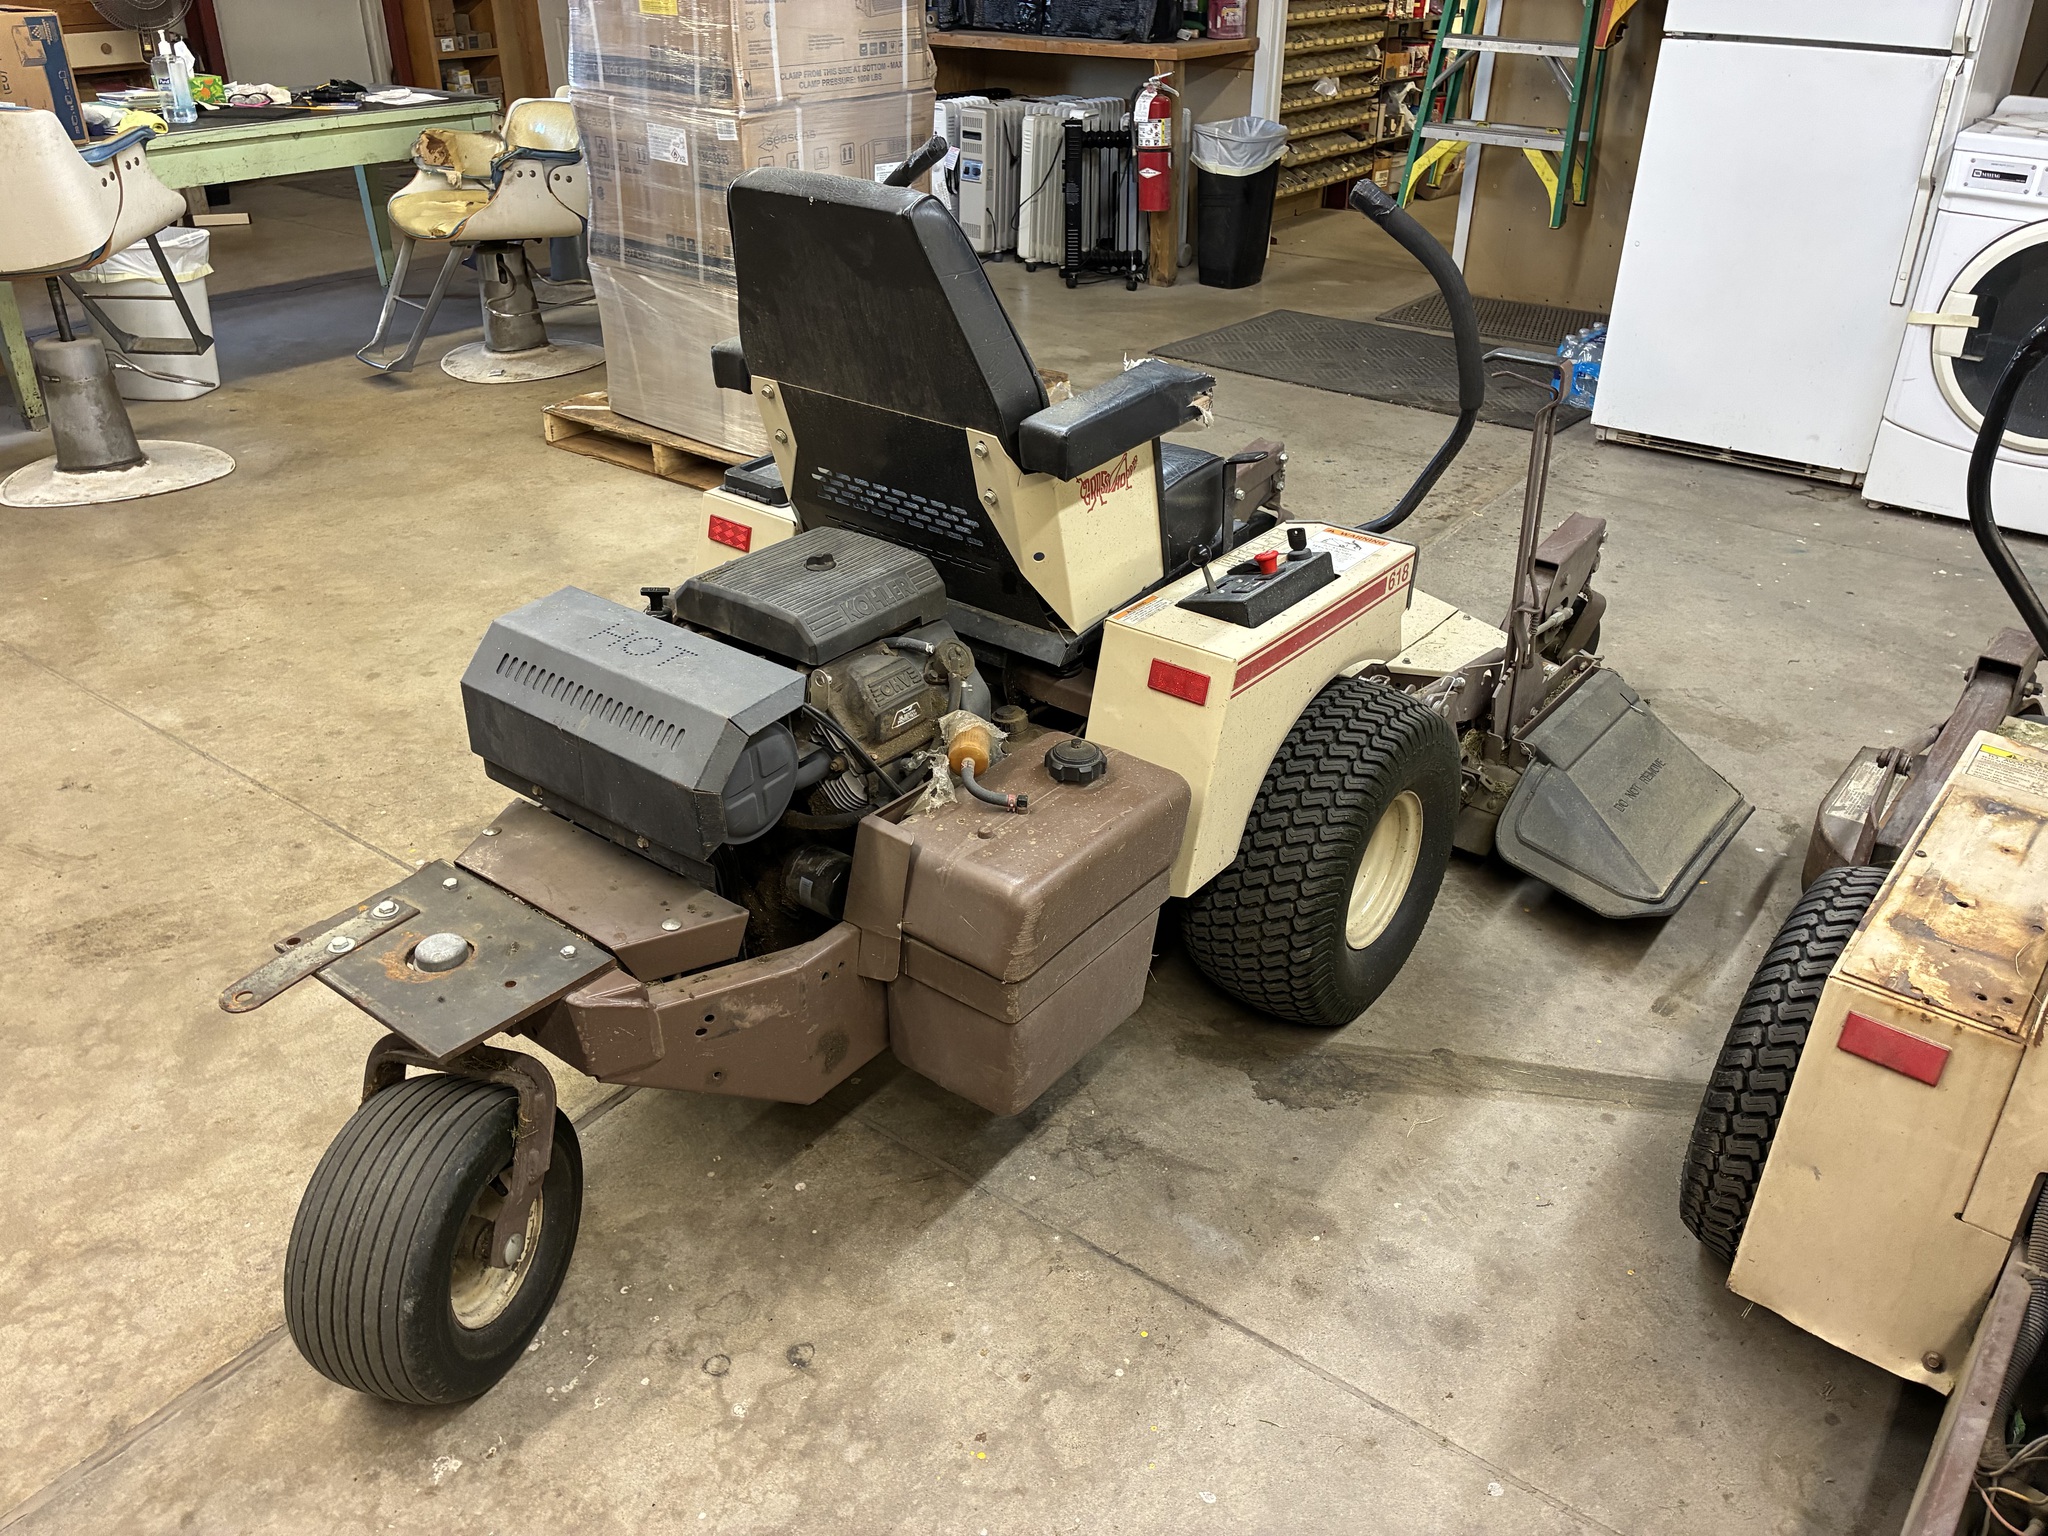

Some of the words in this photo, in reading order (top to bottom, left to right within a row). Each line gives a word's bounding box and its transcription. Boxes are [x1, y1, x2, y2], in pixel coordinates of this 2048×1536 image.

[780, 71, 803, 81] CLAMP
[803, 70, 822, 79] FROM
[823, 67, 838, 76] THIS
[853, 64, 862, 73] AT
[862, 62, 887, 72] BOTTOM
[798, 80, 821, 89] CLAMP
[871, 72, 883, 81] LBS
[1341, 531, 1387, 546] WARNING
[1388, 562, 1409, 591] 618
[839, 576, 916, 623] KOHLER
[588, 623, 699, 667] HOT
[1613, 798, 1629, 813] DO
[1624, 782, 1643, 801] NOT
[1638, 757, 1666, 785] REMOVE
